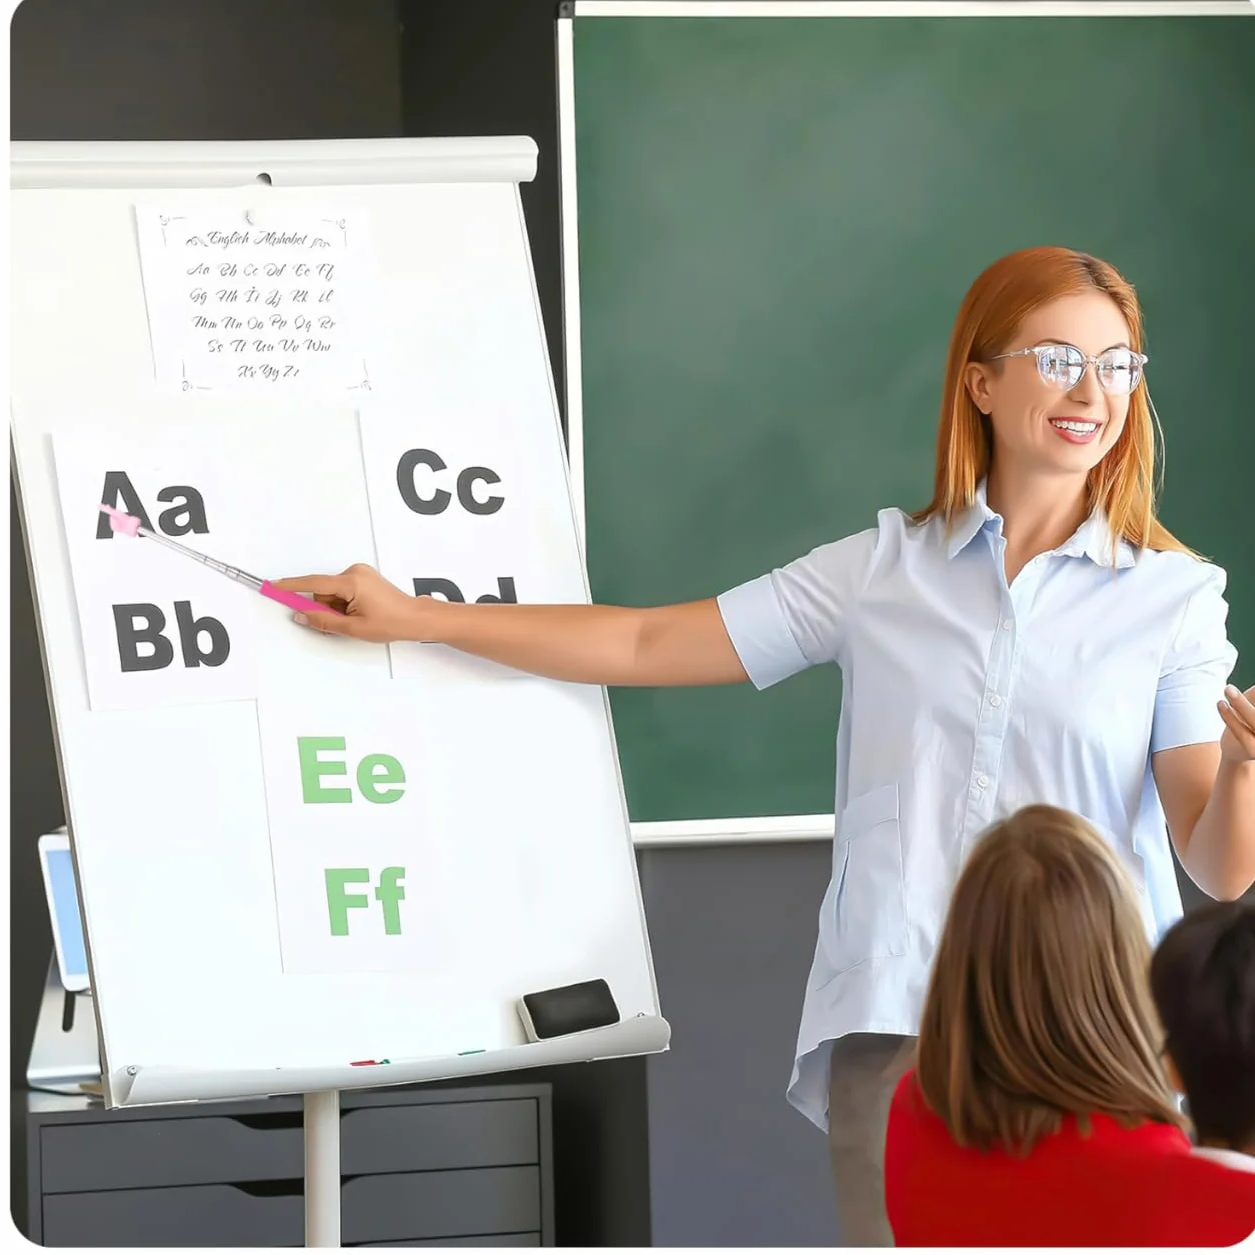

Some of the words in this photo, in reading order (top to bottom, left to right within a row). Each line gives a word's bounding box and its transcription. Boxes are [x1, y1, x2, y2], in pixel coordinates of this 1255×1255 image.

[207, 231, 249, 250] English
[253, 230, 308, 248] Alphabet
[186, 263, 210, 276] Aa
[243, 263, 259, 277] Cc
[263, 262, 286, 277] Dd
[292, 263, 310, 277] Ee
[189, 287, 207, 306] Gg
[265, 289, 282, 308] Jj
[290, 289, 309, 303] Kk
[191, 315, 217, 330] Mm
[247, 316, 264, 330] Oo
[269, 313, 287, 330] Pp
[294, 314, 312, 332] Qq
[318, 315, 336, 330] Rr
[207, 339, 223, 353] Ss
[252, 339, 274, 352] Uu
[278, 338, 300, 353] Vv
[302, 338, 331, 352] Ww
[258, 363, 280, 382] Yy
[396, 448, 505, 515] Cc
[96, 470, 210, 540] Aa
[112, 600, 230, 672] Bb
[297, 736, 406, 804] Ee
[324, 866, 406, 936] Ff
